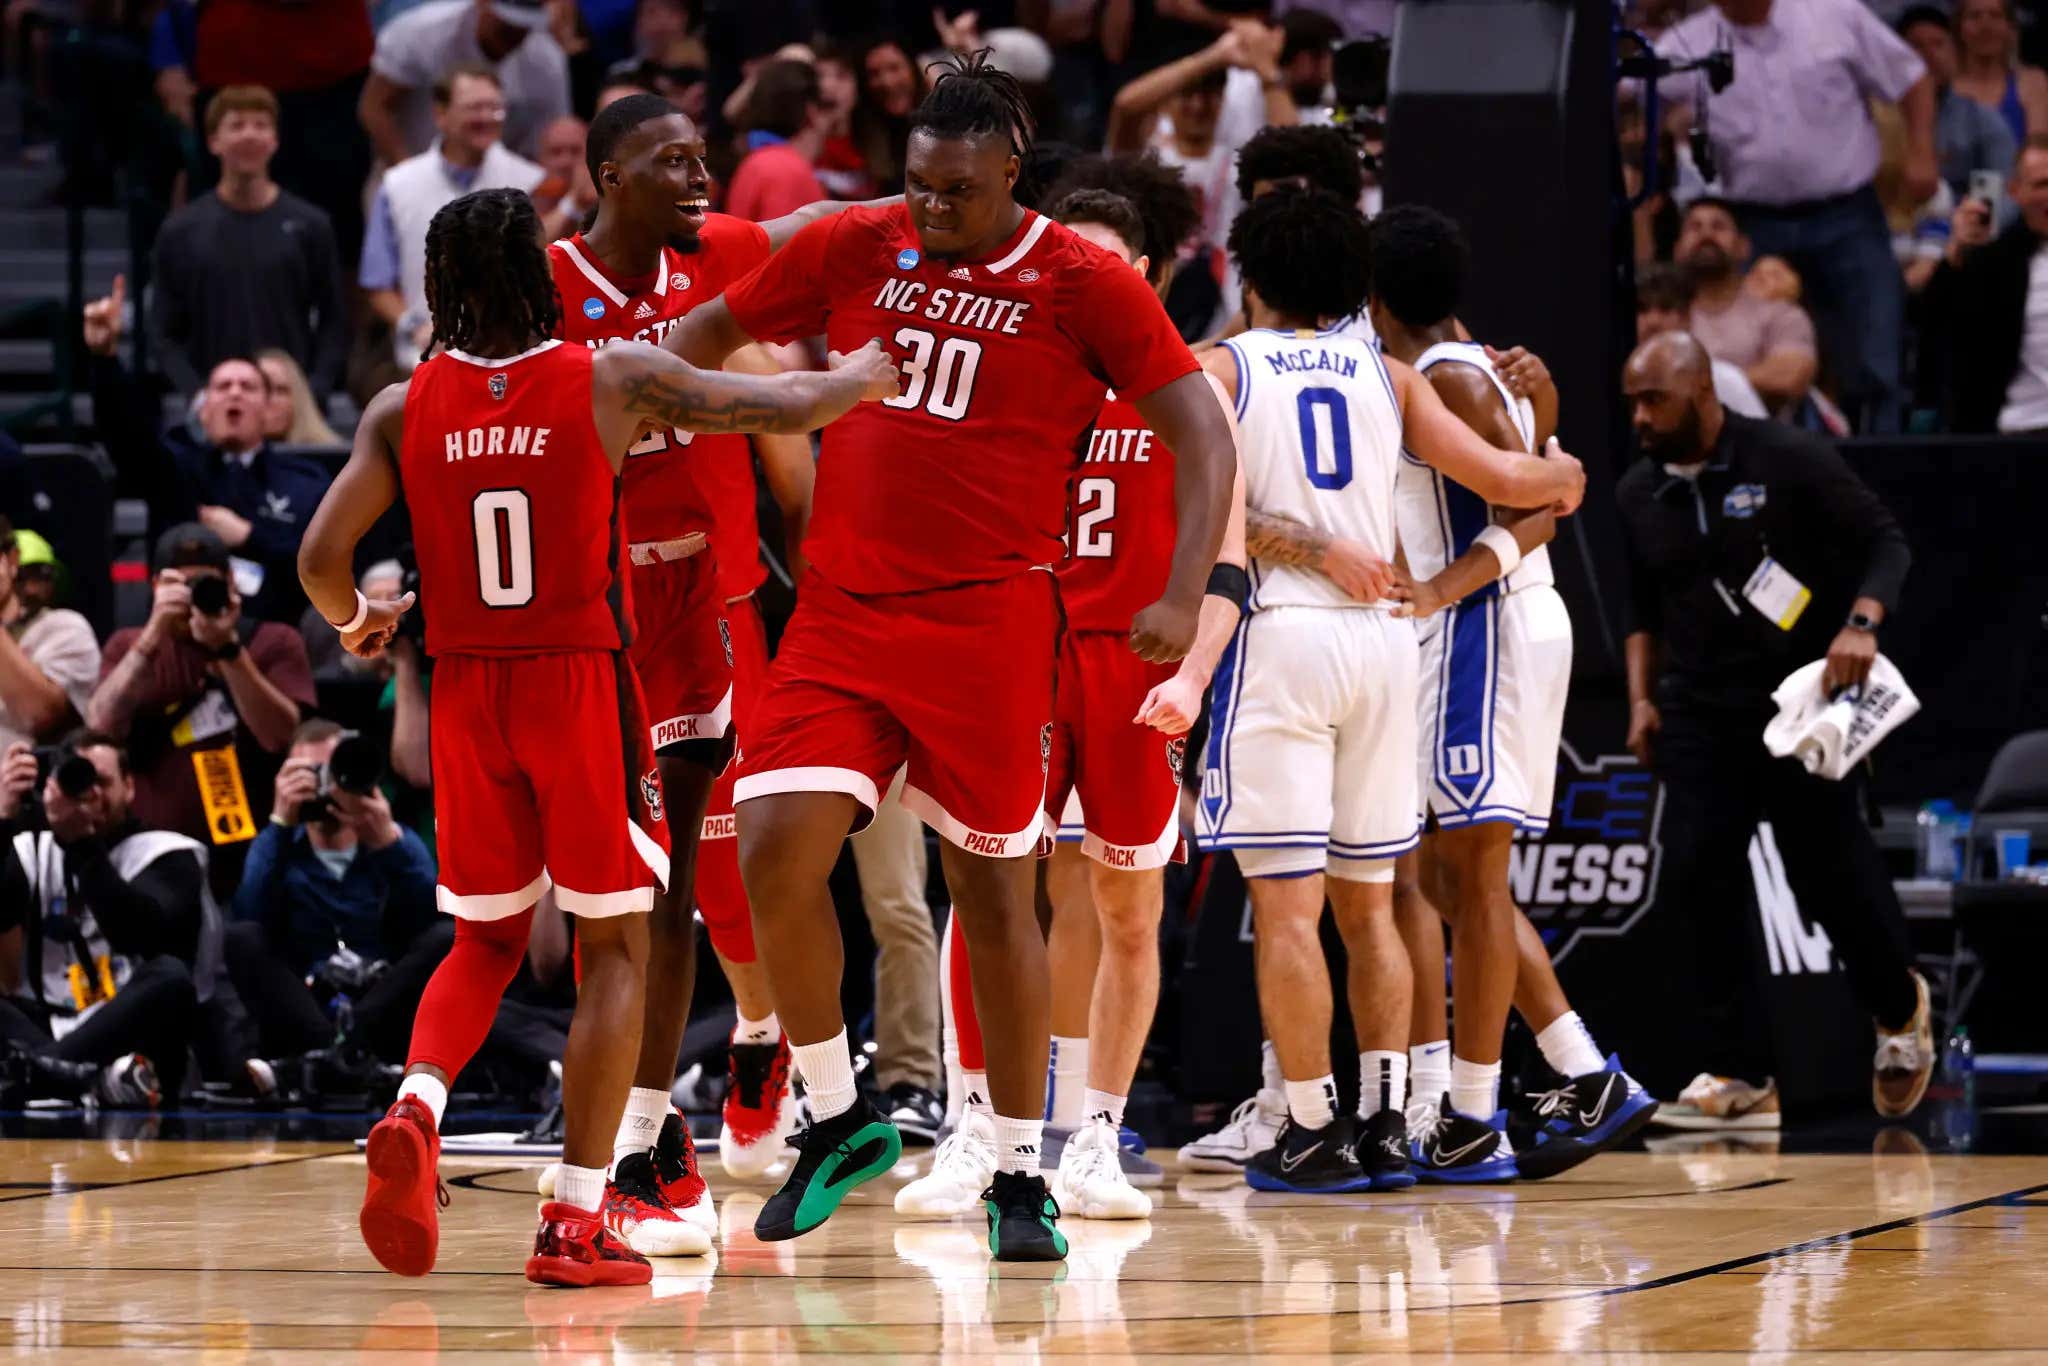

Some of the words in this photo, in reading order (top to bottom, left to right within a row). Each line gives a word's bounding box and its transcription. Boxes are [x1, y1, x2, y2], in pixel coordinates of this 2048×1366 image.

[634, 309, 658, 320] adidas
[873, 277, 927, 313] NC
[924, 288, 1031, 335] STATE
[882, 327, 983, 421] 30
[445, 426, 551, 463] HORNE
[1296, 387, 1353, 490] 0
[1066, 477, 1116, 558] 2
[473, 488, 534, 609] 0
[657, 718, 699, 745] PACK
[1446, 743, 1481, 776] D
[705, 817, 737, 837] PAC
[963, 831, 1009, 856] PACK
[1103, 844, 1136, 867] PACK
[1508, 843, 1649, 904] NESS
